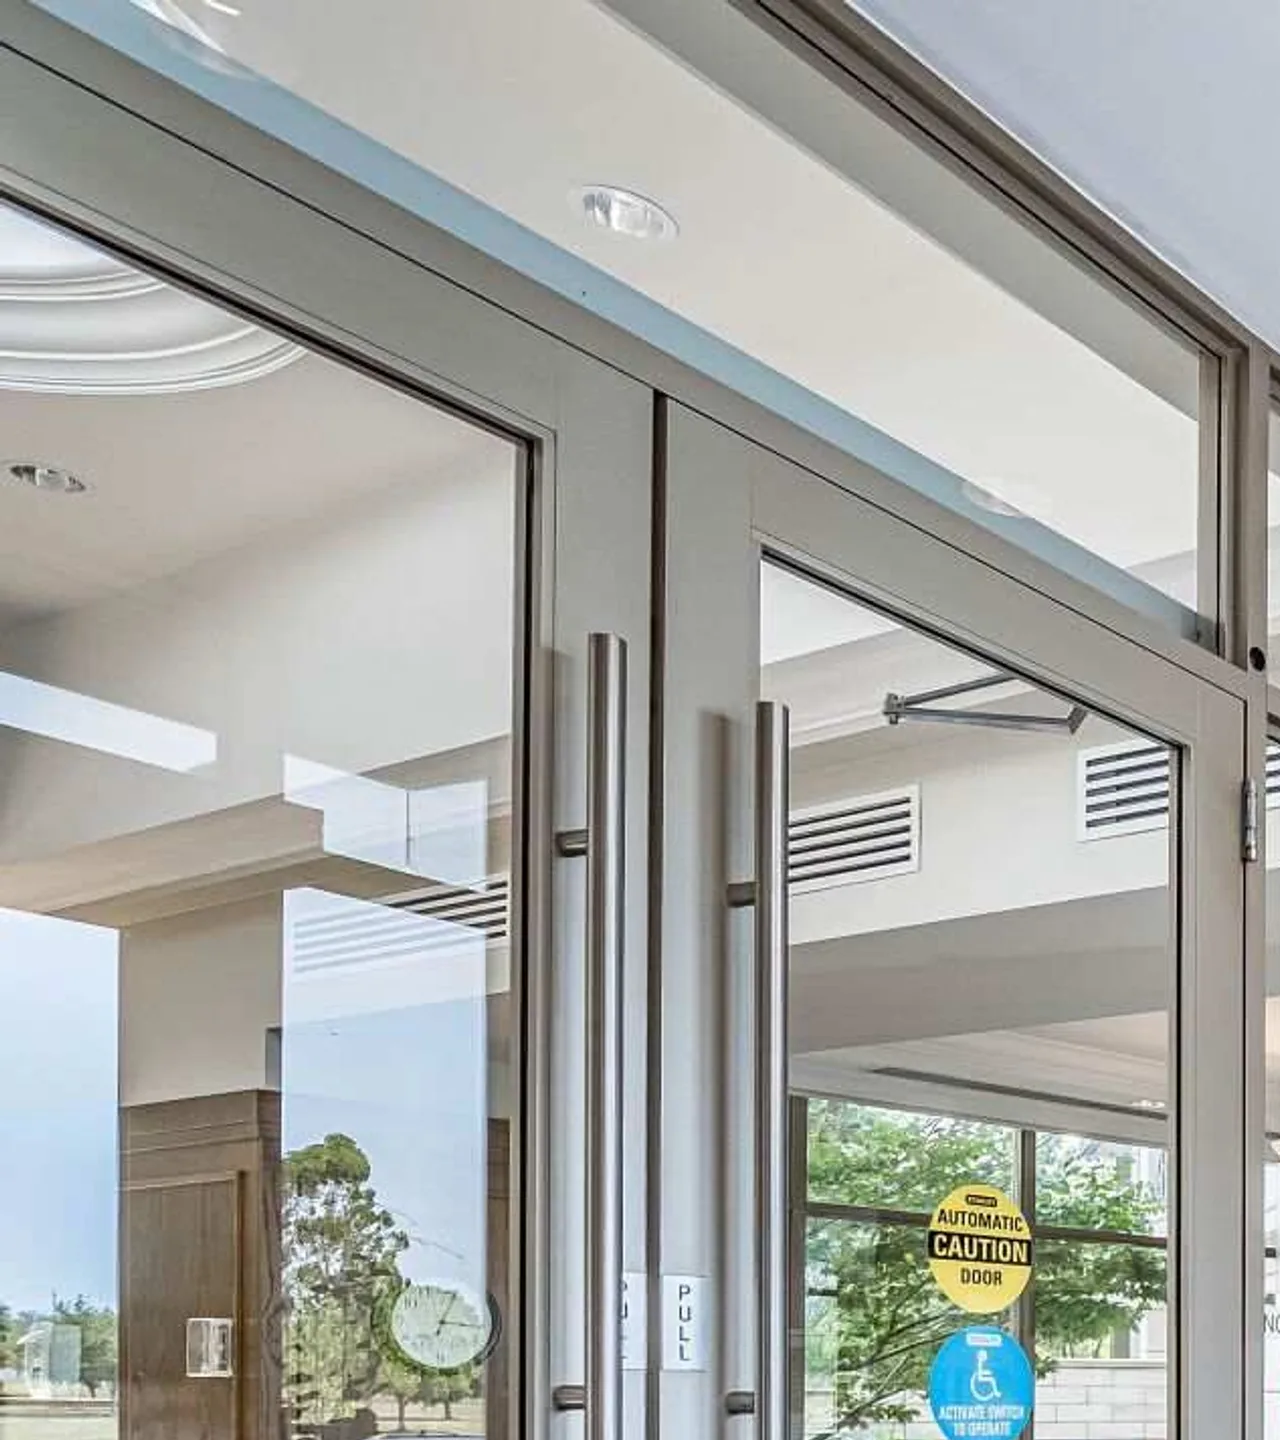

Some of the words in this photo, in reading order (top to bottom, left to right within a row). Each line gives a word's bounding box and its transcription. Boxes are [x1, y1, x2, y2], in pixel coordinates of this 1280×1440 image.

[938, 1208, 1023, 1232] AUTOMATIC
[933, 1234, 1029, 1263] CAUTION
[960, 1267, 1003, 1285] DOOR
[678, 1284, 692, 1361] PULL
[939, 1405, 986, 1420] ACTIVATE
[954, 1421, 966, 1436] TO
[968, 1421, 1011, 1437] OPERATE
